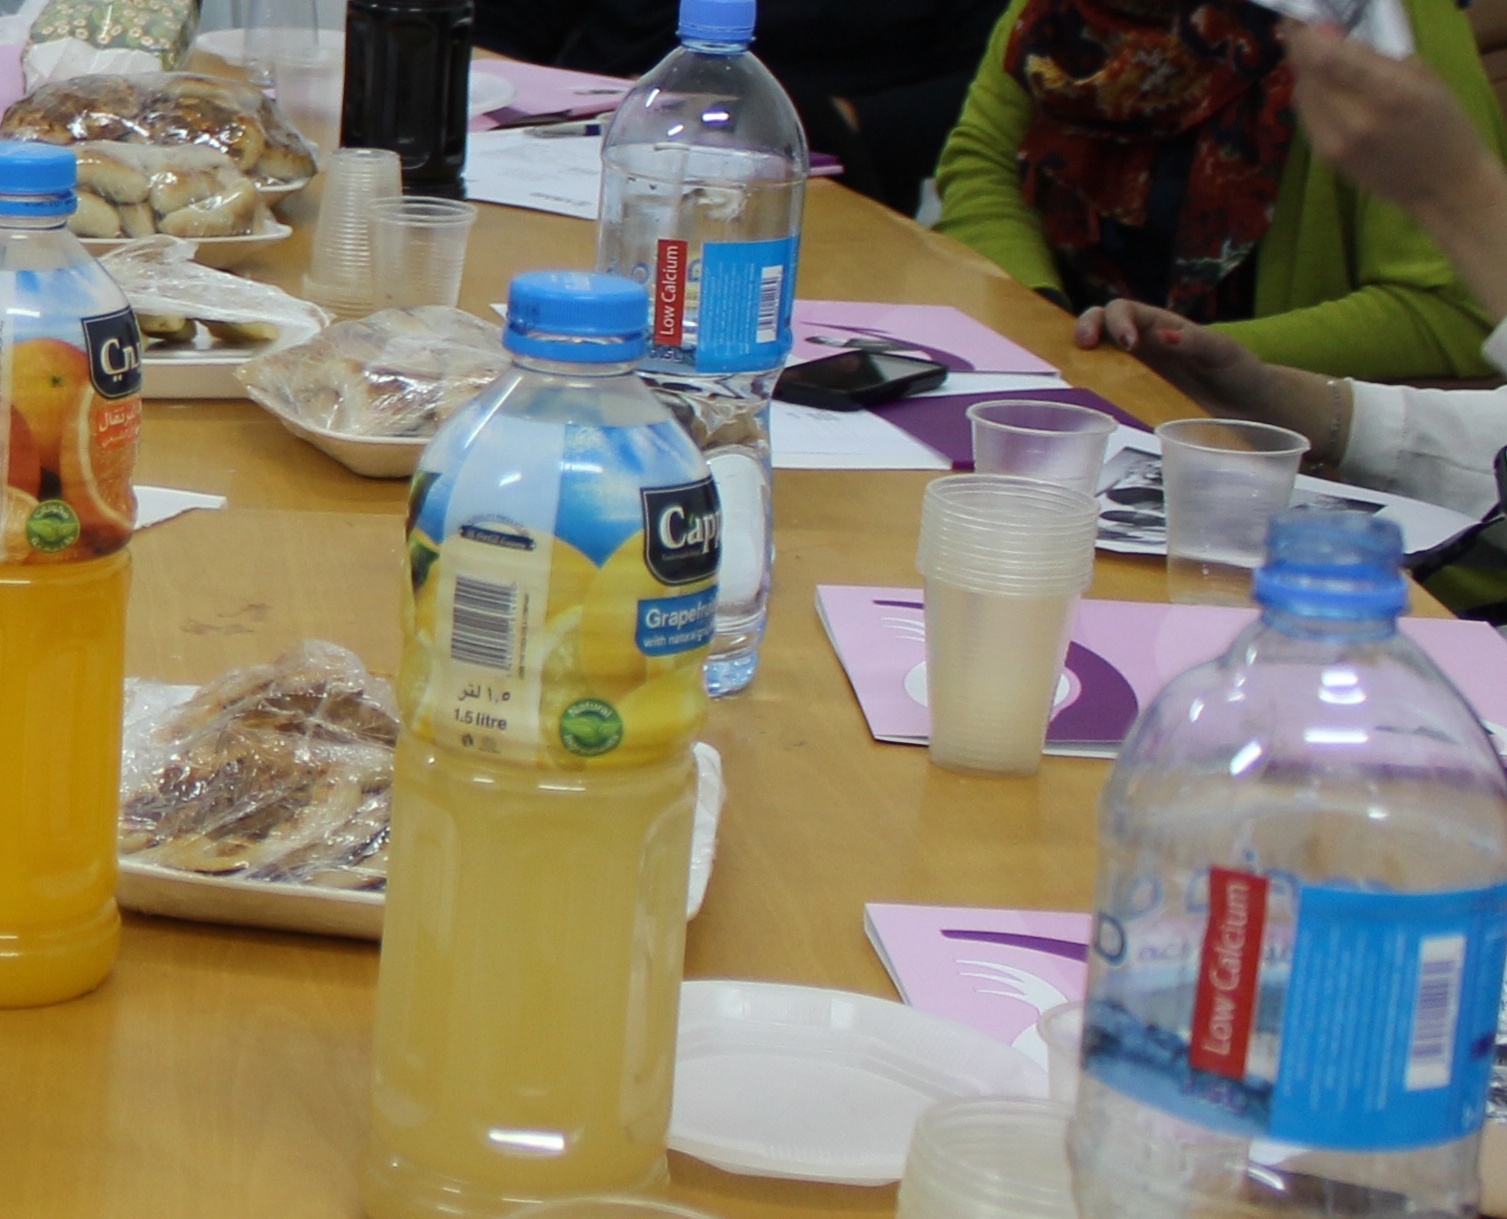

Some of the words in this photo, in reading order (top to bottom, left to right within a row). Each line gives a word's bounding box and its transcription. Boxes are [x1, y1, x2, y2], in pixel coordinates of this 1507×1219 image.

[661, 245, 679, 303] Calcium
[660, 305, 676, 336] Low
[658, 505, 722, 554] Capp
[454, 707, 473, 725] 1.5
[476, 713, 507, 730] litre
